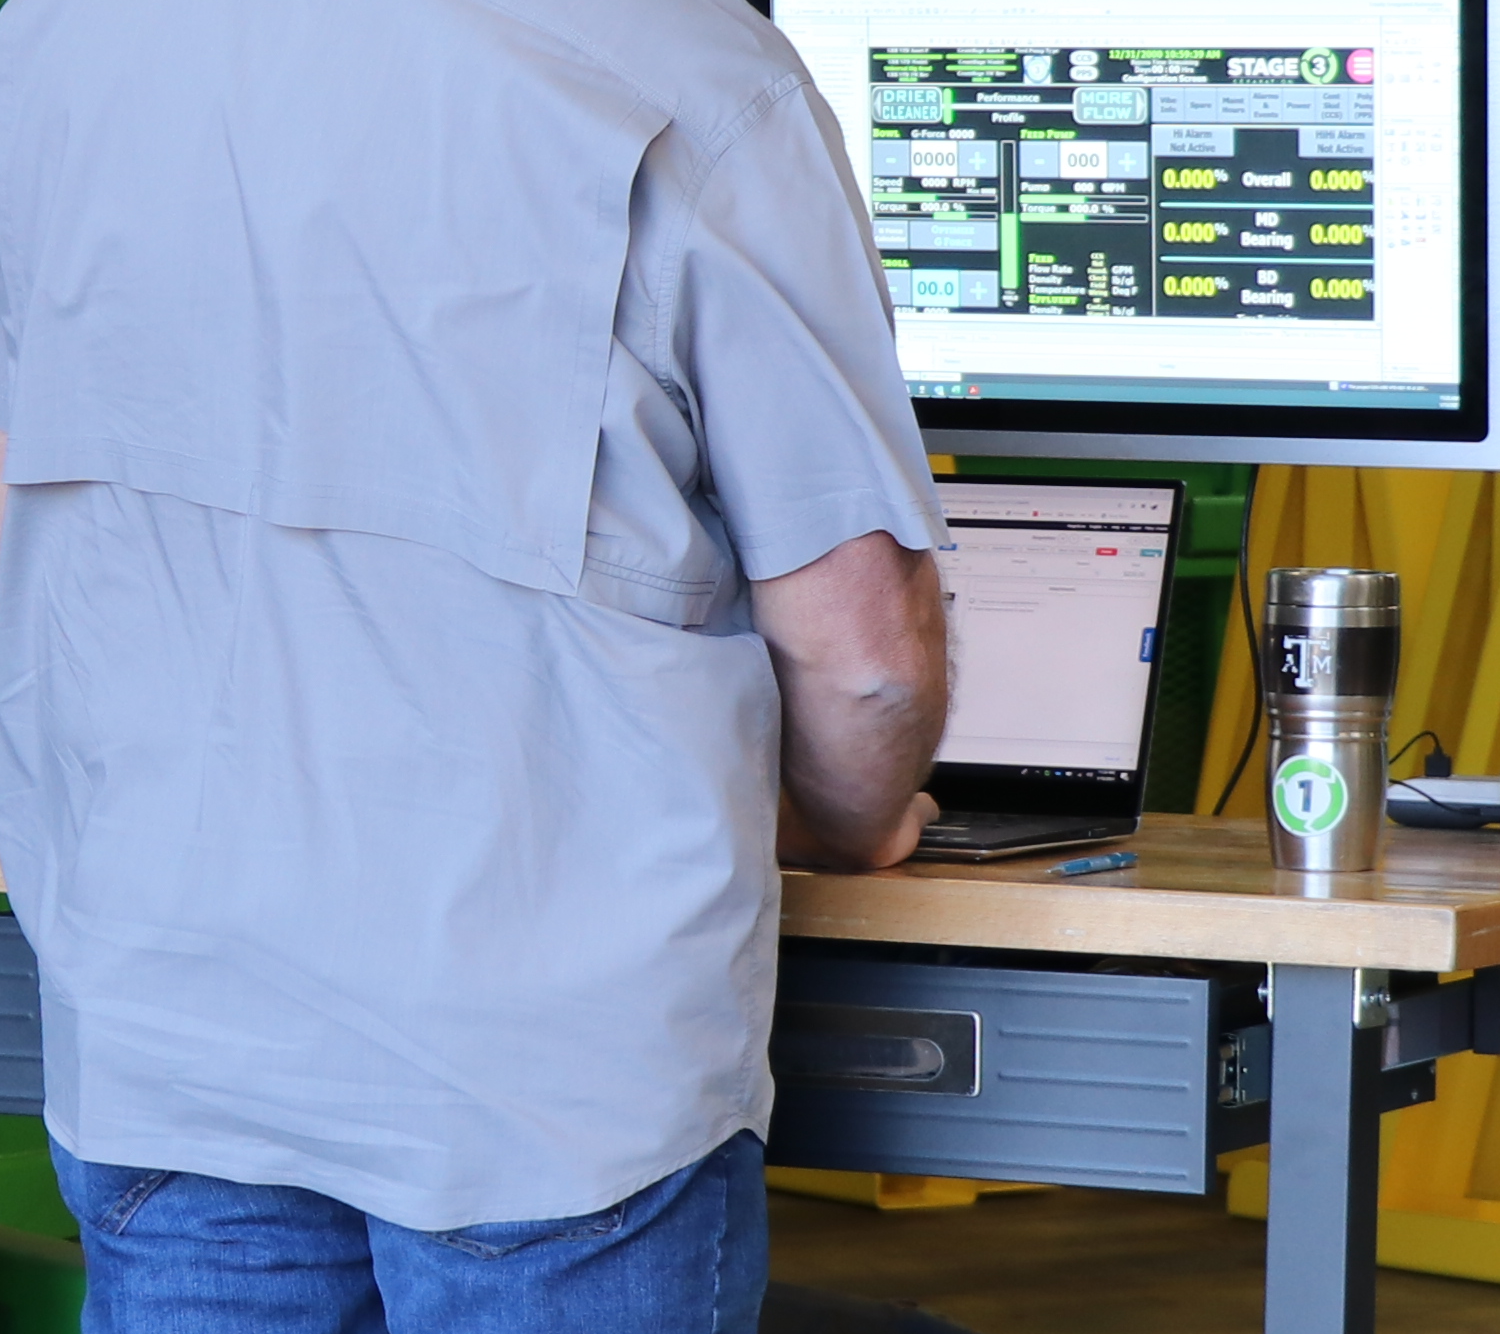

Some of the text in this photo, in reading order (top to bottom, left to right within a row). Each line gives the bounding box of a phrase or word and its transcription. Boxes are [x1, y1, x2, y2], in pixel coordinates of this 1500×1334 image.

[1227, 57, 1327, 76] STAGE 3
[1122, 74, 1208, 84] Configuration Screen
[883, 90, 937, 103] DRIER
[976, 92, 1041, 103] Performance
[1081, 91, 1133, 104] MORE
[1253, 92, 1279, 100] Alarms
[1222, 105, 1246, 114] Hours
[1286, 102, 1311, 110] Power
[882, 106, 938, 120] CLEANER
[991, 112, 1025, 124] Profile
[1083, 107, 1132, 120] FLOW
[1253, 110, 1279, 119] Events
[911, 129, 976, 139] G-Force 0000
[1173, 129, 1212, 139] Hi Alarm
[1338, 130, 1365, 139] Alarm
[1170, 143, 1216, 153] Not Active
[1317, 144, 1364, 154] Not Active
[913, 152, 956, 166] 0000
[1068, 153, 1100, 167] 000
[873, 178, 903, 189] Speed
[952, 178, 976, 188] RPM
[1242, 171, 1292, 188] Overall
[1020, 182, 1051, 193] Pump
[873, 202, 908, 213] Torque
[1021, 204, 1057, 214] Torque
[1255, 212, 1280, 227] MD
[1240, 231, 1295, 250] Bearing
[1028, 264, 1073, 274] Flow Rate
[1111, 265, 1133, 275] GPM
[1028, 274, 1063, 285] Density
[1256, 270, 1279, 285] BD
[917, 281, 954, 295] 00.0
[1028, 284, 1086, 296] Temperature
[1240, 289, 1295, 308] Bearing
[1029, 305, 1063, 314] Density
[1298, 779, 1313, 813] 1
